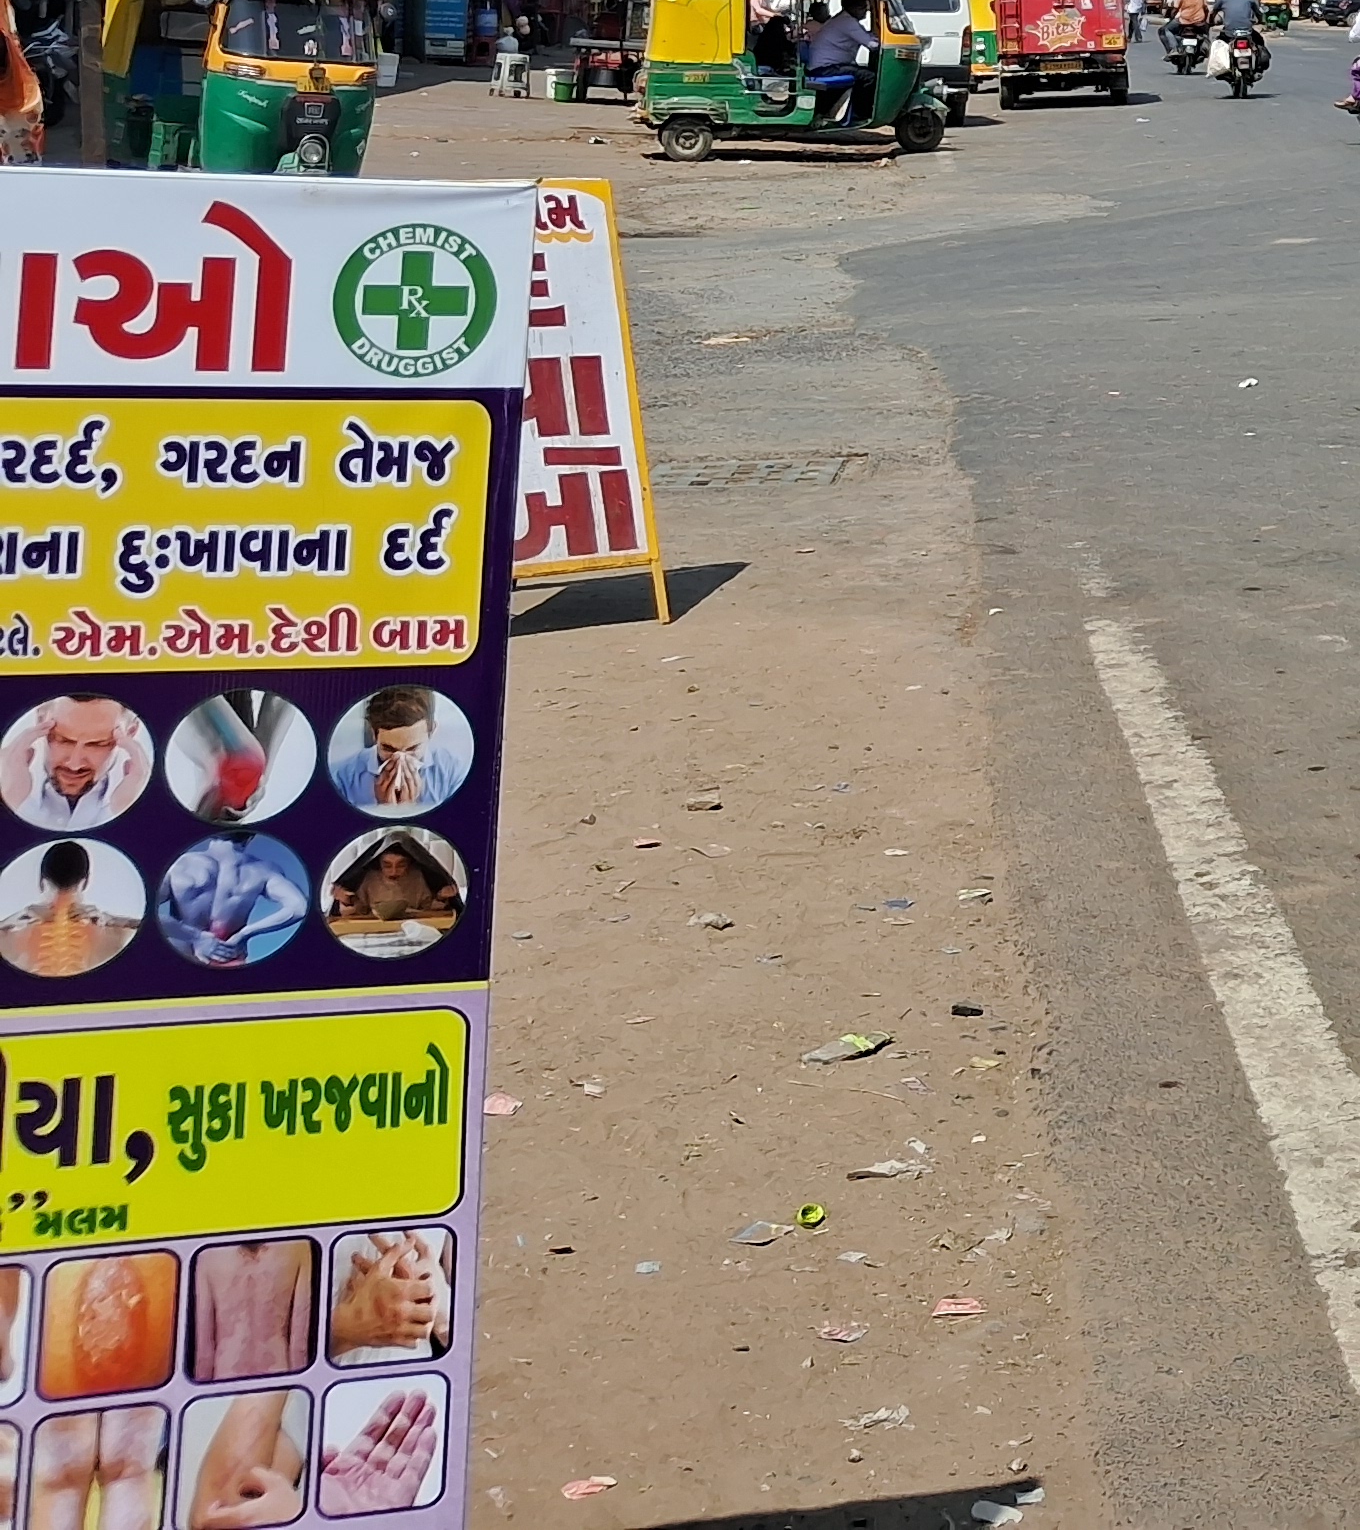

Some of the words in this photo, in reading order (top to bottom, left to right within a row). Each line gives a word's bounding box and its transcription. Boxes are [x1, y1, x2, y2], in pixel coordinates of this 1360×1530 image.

[362, 226, 477, 262] CHEMIST
[350, 336, 471, 376] DRUGGIST
[161, 438, 301, 484] ગરદન
[338, 420, 456, 484] તેમજ
[383, 507, 455, 571] દર્દ
[372, 617, 467, 652] બામ
[167, 1080, 247, 1173] સુકા
[260, 1041, 450, 1137] ખરજવાનો
[32, 1202, 130, 1239] મલમ
